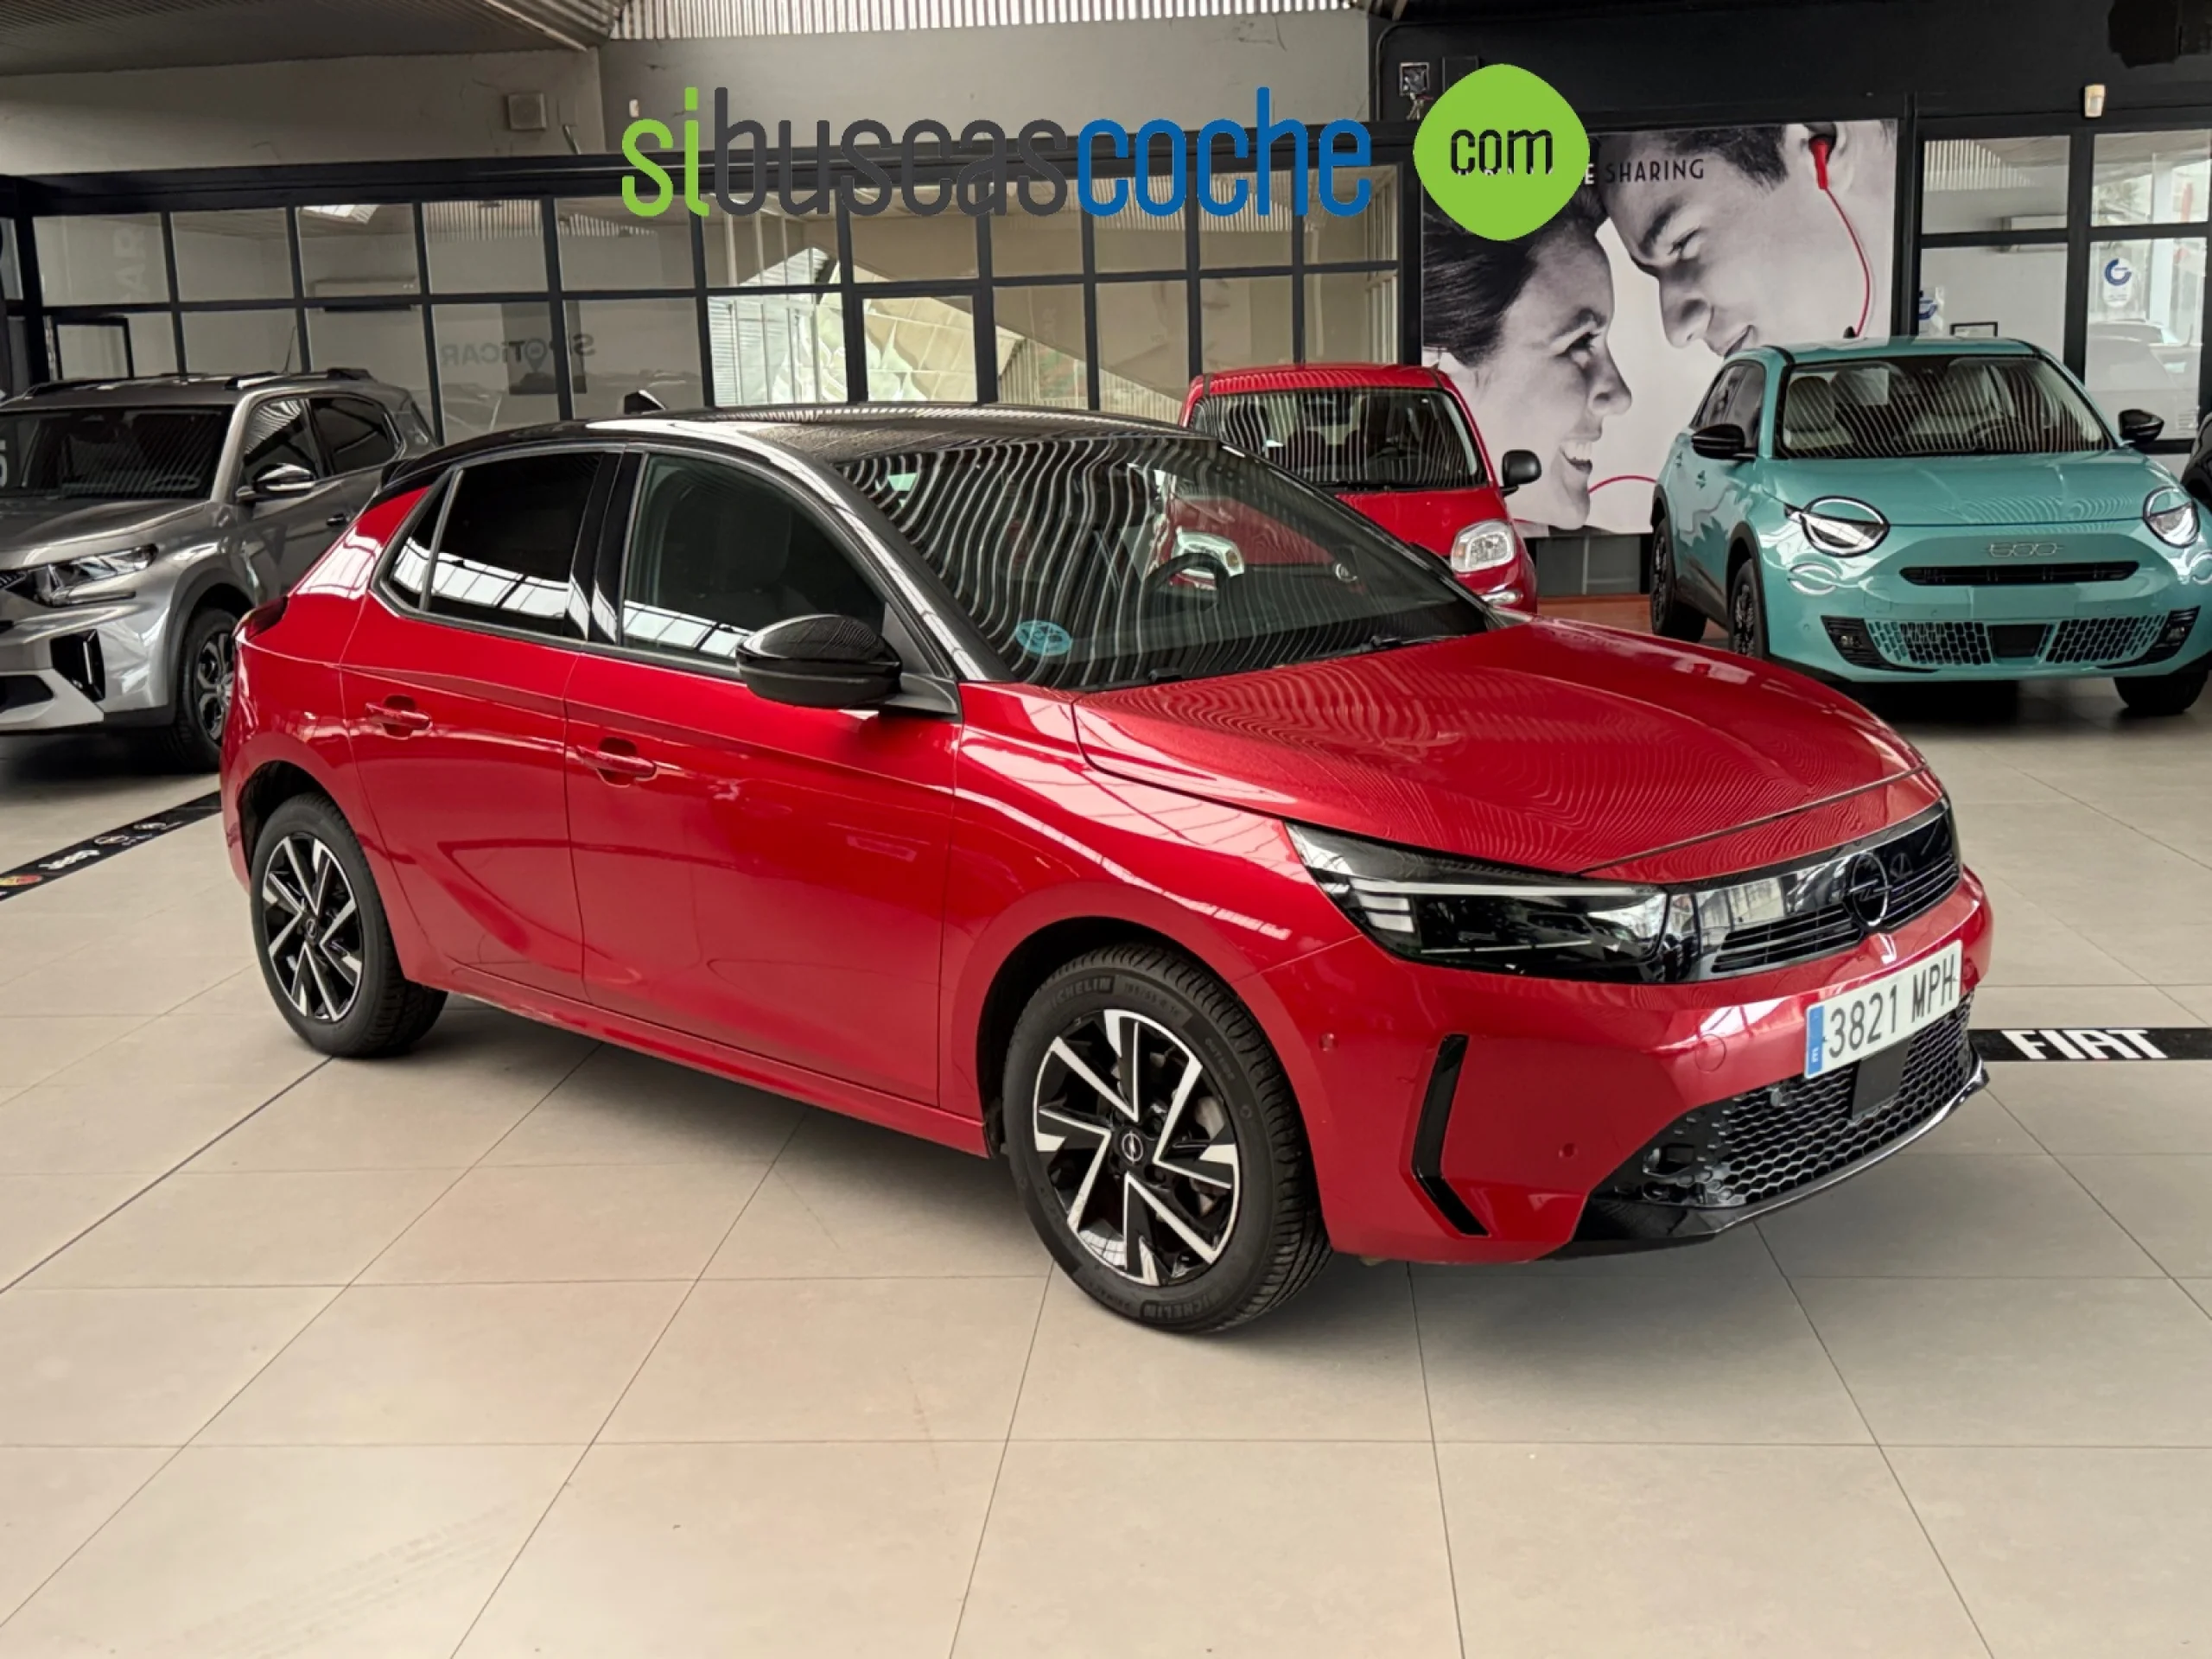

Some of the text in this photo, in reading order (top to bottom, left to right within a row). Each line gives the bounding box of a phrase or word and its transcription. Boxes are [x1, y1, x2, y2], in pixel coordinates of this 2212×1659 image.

[1604, 158, 1705, 184] SHARING
[1828, 953, 1956, 1058] 3821 MPH
[1810, 1046, 1820, 1063] E
[1999, 1029, 2169, 1060] FIAT
